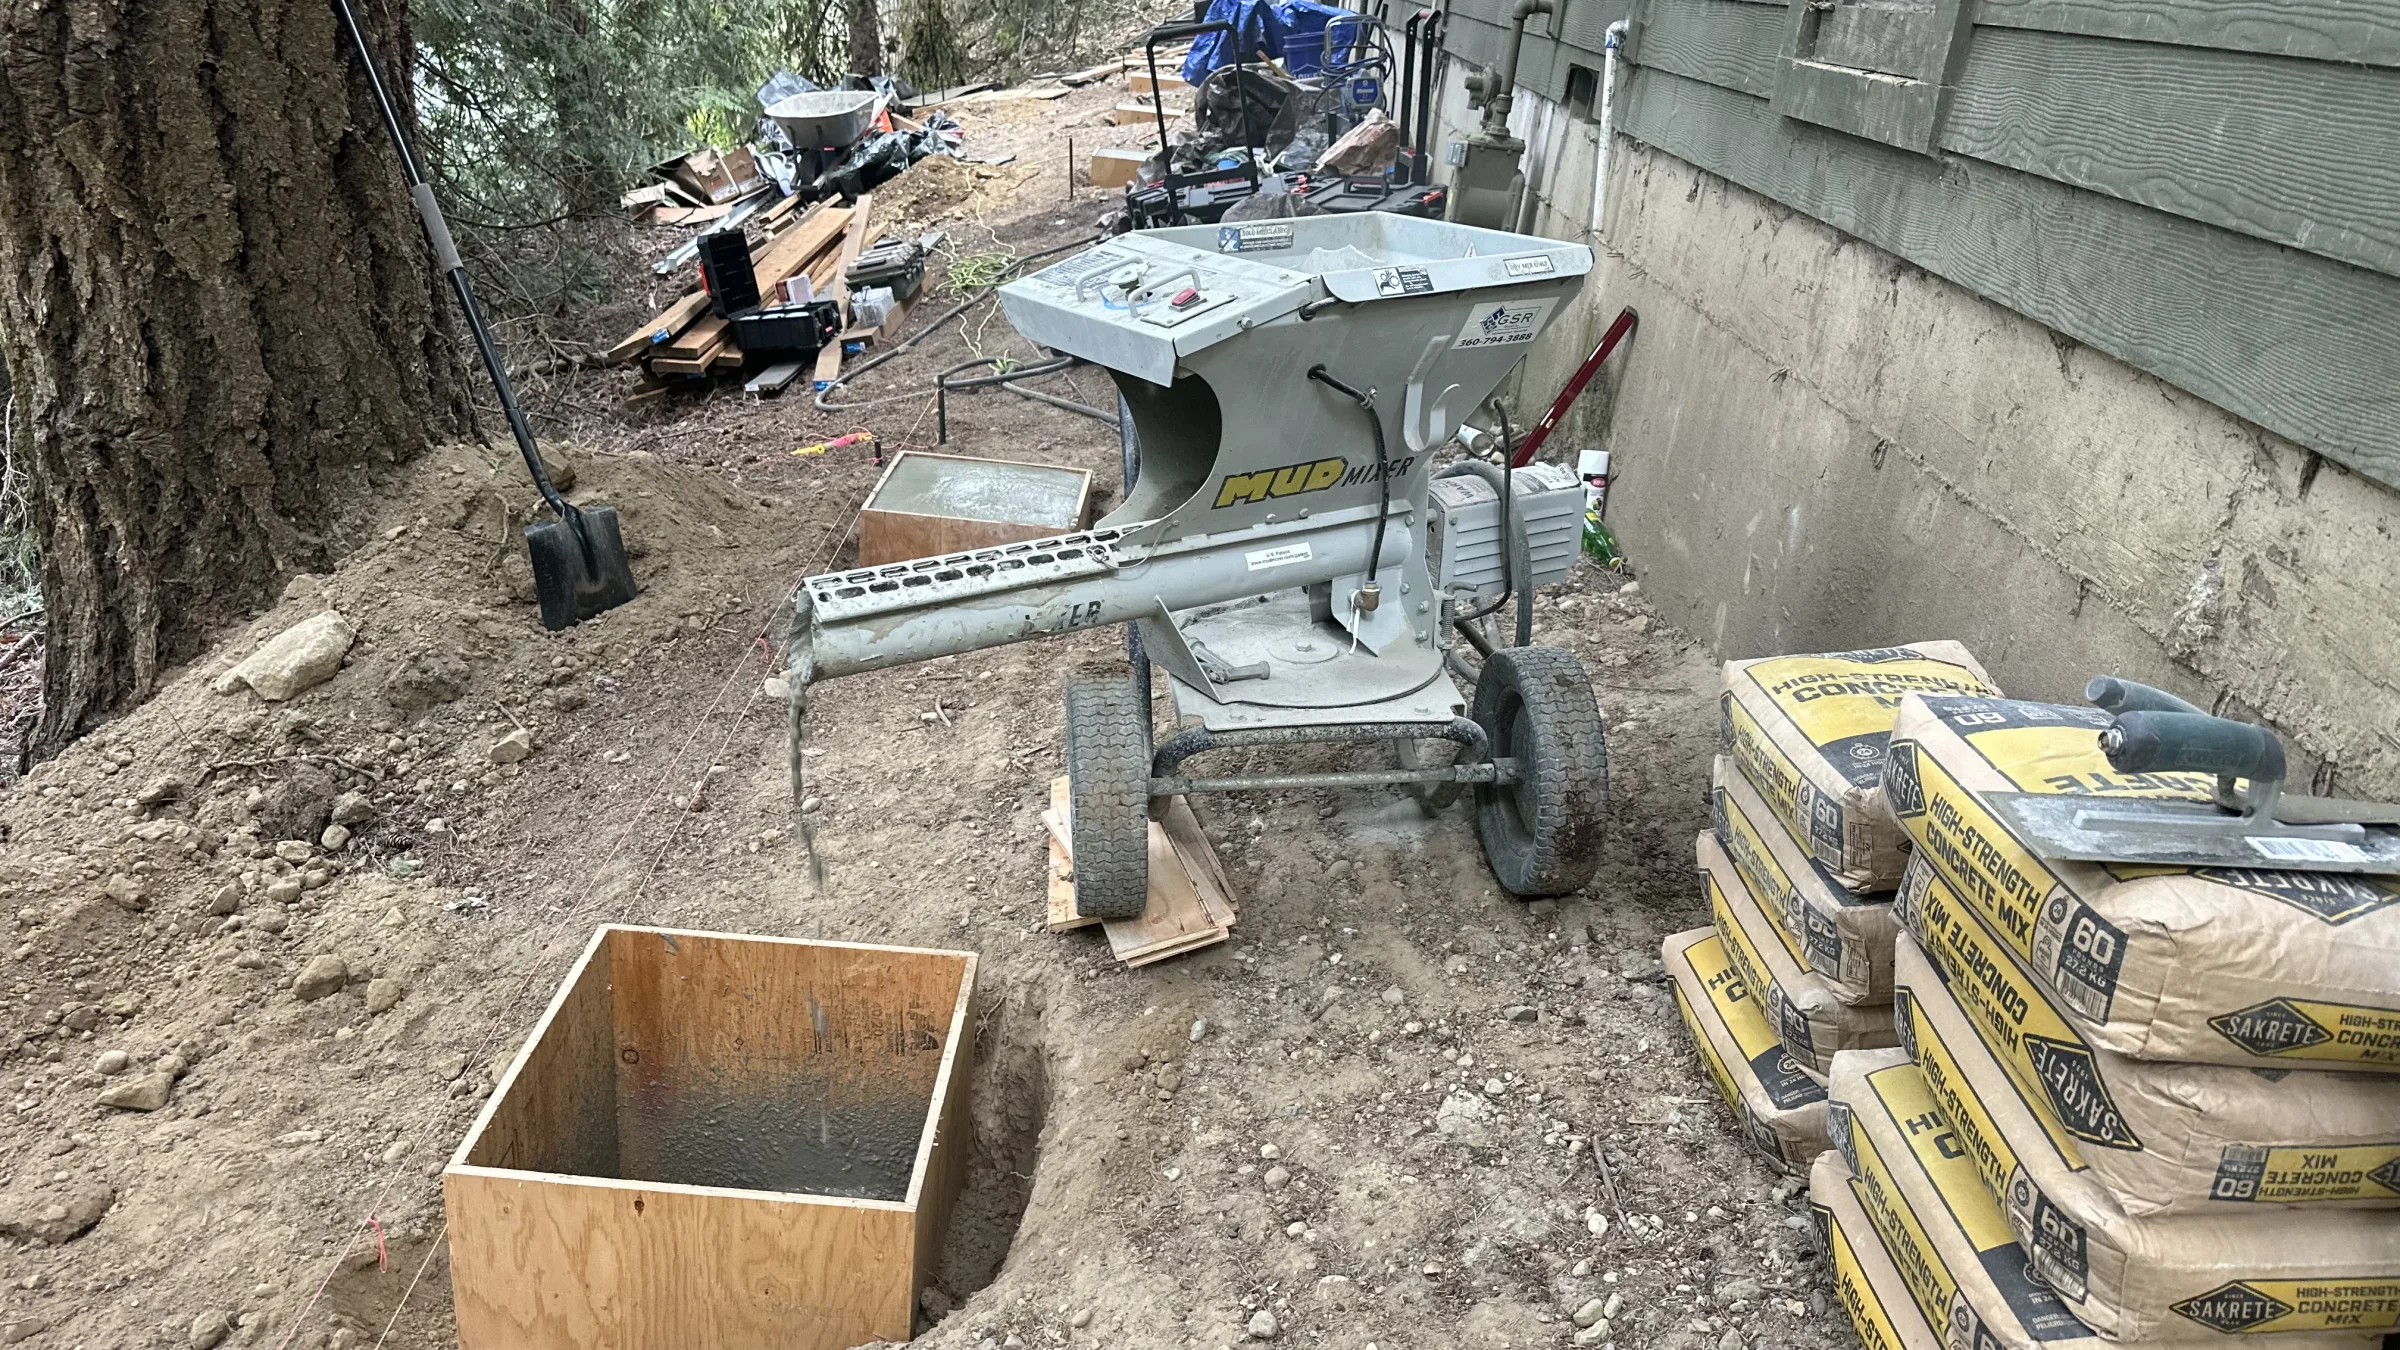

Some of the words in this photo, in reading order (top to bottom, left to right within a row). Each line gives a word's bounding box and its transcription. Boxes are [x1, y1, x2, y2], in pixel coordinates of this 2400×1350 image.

[1498, 312, 1533, 325] GSR
[1458, 332, 1533, 347] 360-794-3888
[1211, 455, 1349, 510] MUD
[1341, 456, 1416, 488] MIXER
[1738, 724, 1796, 802] HIGH-STRENGTH
[1815, 798, 1838, 830] 60
[1929, 792, 2041, 914] HIGH-STRENGTH
[1926, 820, 1996, 913] CONCRETE
[1998, 900, 2031, 947] MIX
[1924, 889, 1952, 935] MIX
[1716, 911, 1767, 1001] HIGH-STRENGTH
[2072, 916, 2115, 966] 60
[1948, 921, 2028, 1026] CONCRETE
[2065, 954, 2088, 977] 27.2
[2088, 971, 2107, 988] KG
[2227, 1015, 2317, 1045] SAKRETE
[2337, 1029, 2400, 1049] CONCR
[2339, 1013, 2400, 1031] HIGH-STR
[2034, 1040, 2118, 1142] SAKRETE
[1922, 1046, 2007, 1191] HIGH-STRENGTH
[2264, 1170, 2364, 1186] CONCRETE
[2302, 1153, 2338, 1170] MIX
[2216, 1177, 2255, 1199] 60
[2258, 1185, 2361, 1198] HIGH-STRENGTH
[1864, 1165, 1948, 1313] HIGH-STRENGTH
[2040, 1205, 2078, 1252] 60
[1841, 1271, 1889, 1350] HIGH-STR
[2188, 1300, 2276, 1320] SAKRETE
[2297, 1299, 2400, 1315] CONCRETE
[2324, 1313, 2363, 1326] MIX
